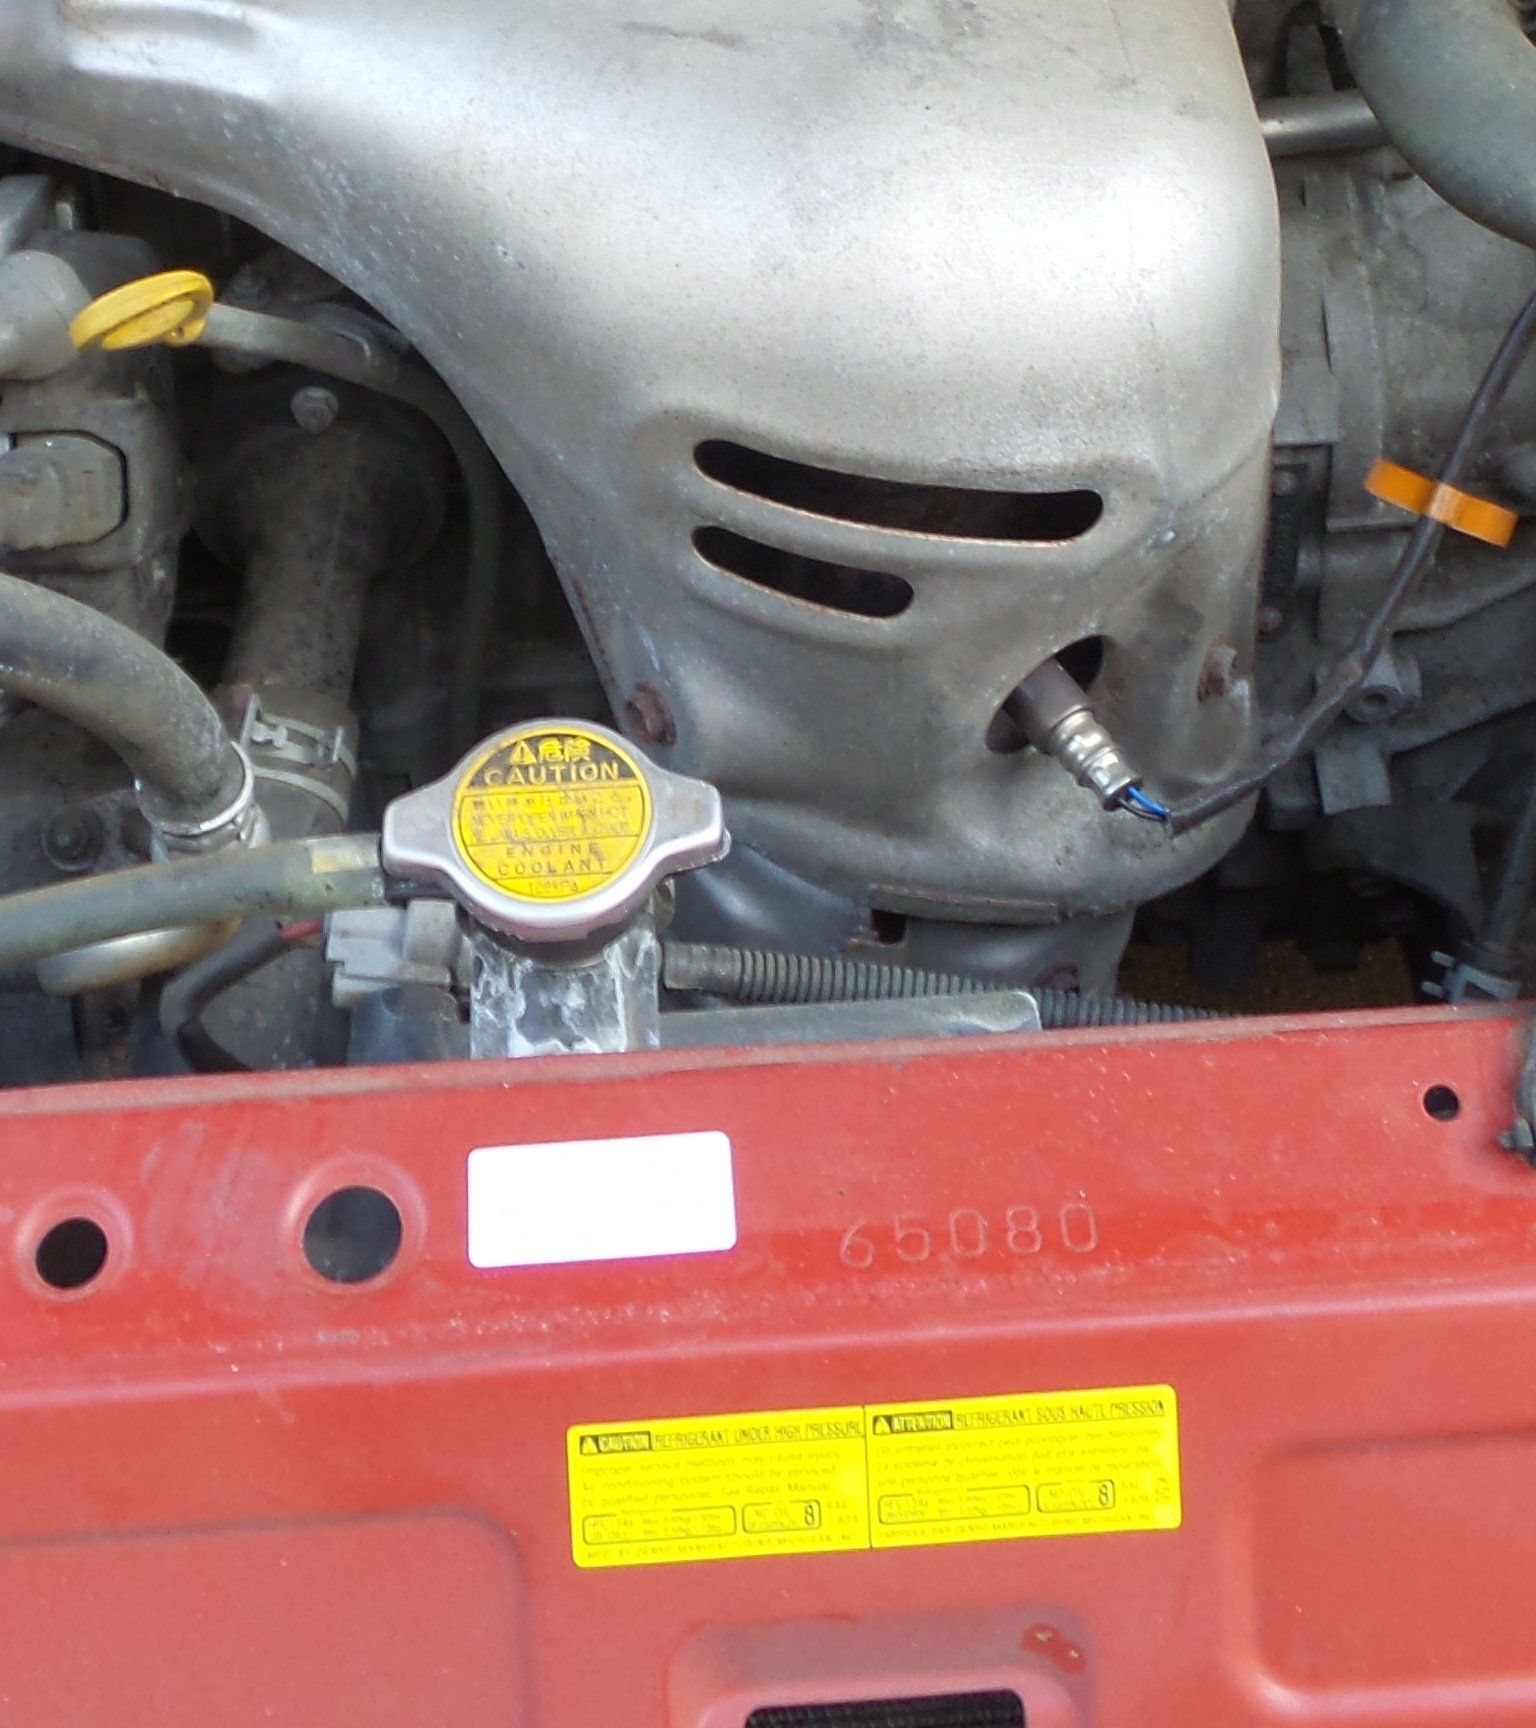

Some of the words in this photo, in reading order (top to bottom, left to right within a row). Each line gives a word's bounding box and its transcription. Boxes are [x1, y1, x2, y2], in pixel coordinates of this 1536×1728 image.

[483, 761, 619, 786] CAUTION
[506, 843, 601, 858] ENGINE
[498, 858, 606, 876] COOLANT
[839, 1203, 1098, 1269] 65080
[892, 1411, 951, 1432] ATTENTION
[1036, 1405, 1065, 1423] SOUS
[1070, 1402, 1106, 1421] HAUTE
[1109, 1398, 1165, 1418] PRESSION
[598, 1432, 650, 1452] CAUTION
[654, 1427, 729, 1449] REFRIGERANT
[733, 1425, 770, 1444] UNDER
[773, 1423, 801, 1441] HIGH
[804, 1418, 863, 1439] PRESSURE
